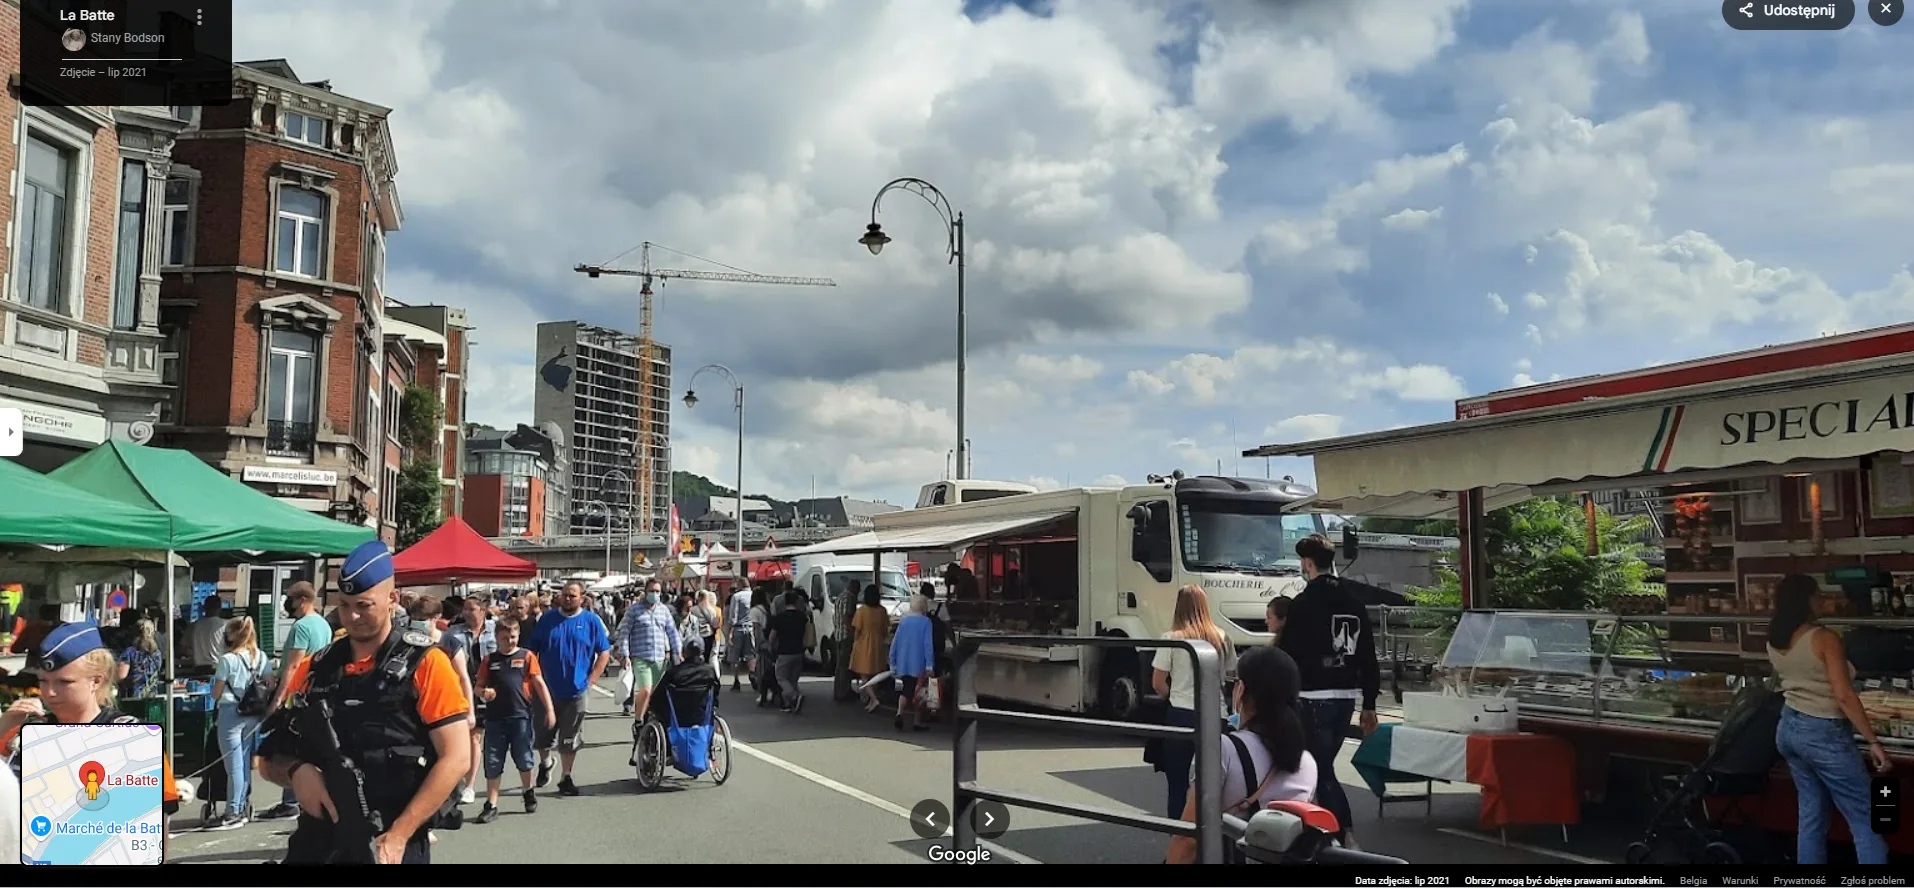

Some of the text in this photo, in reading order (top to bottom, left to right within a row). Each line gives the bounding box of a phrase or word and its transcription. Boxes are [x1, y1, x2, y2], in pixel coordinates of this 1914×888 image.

[247, 470, 335, 482] www.marcelisluc.be
[1203, 579, 1265, 589] BOUCHERIE
[1259, 586, 1277, 597] de
